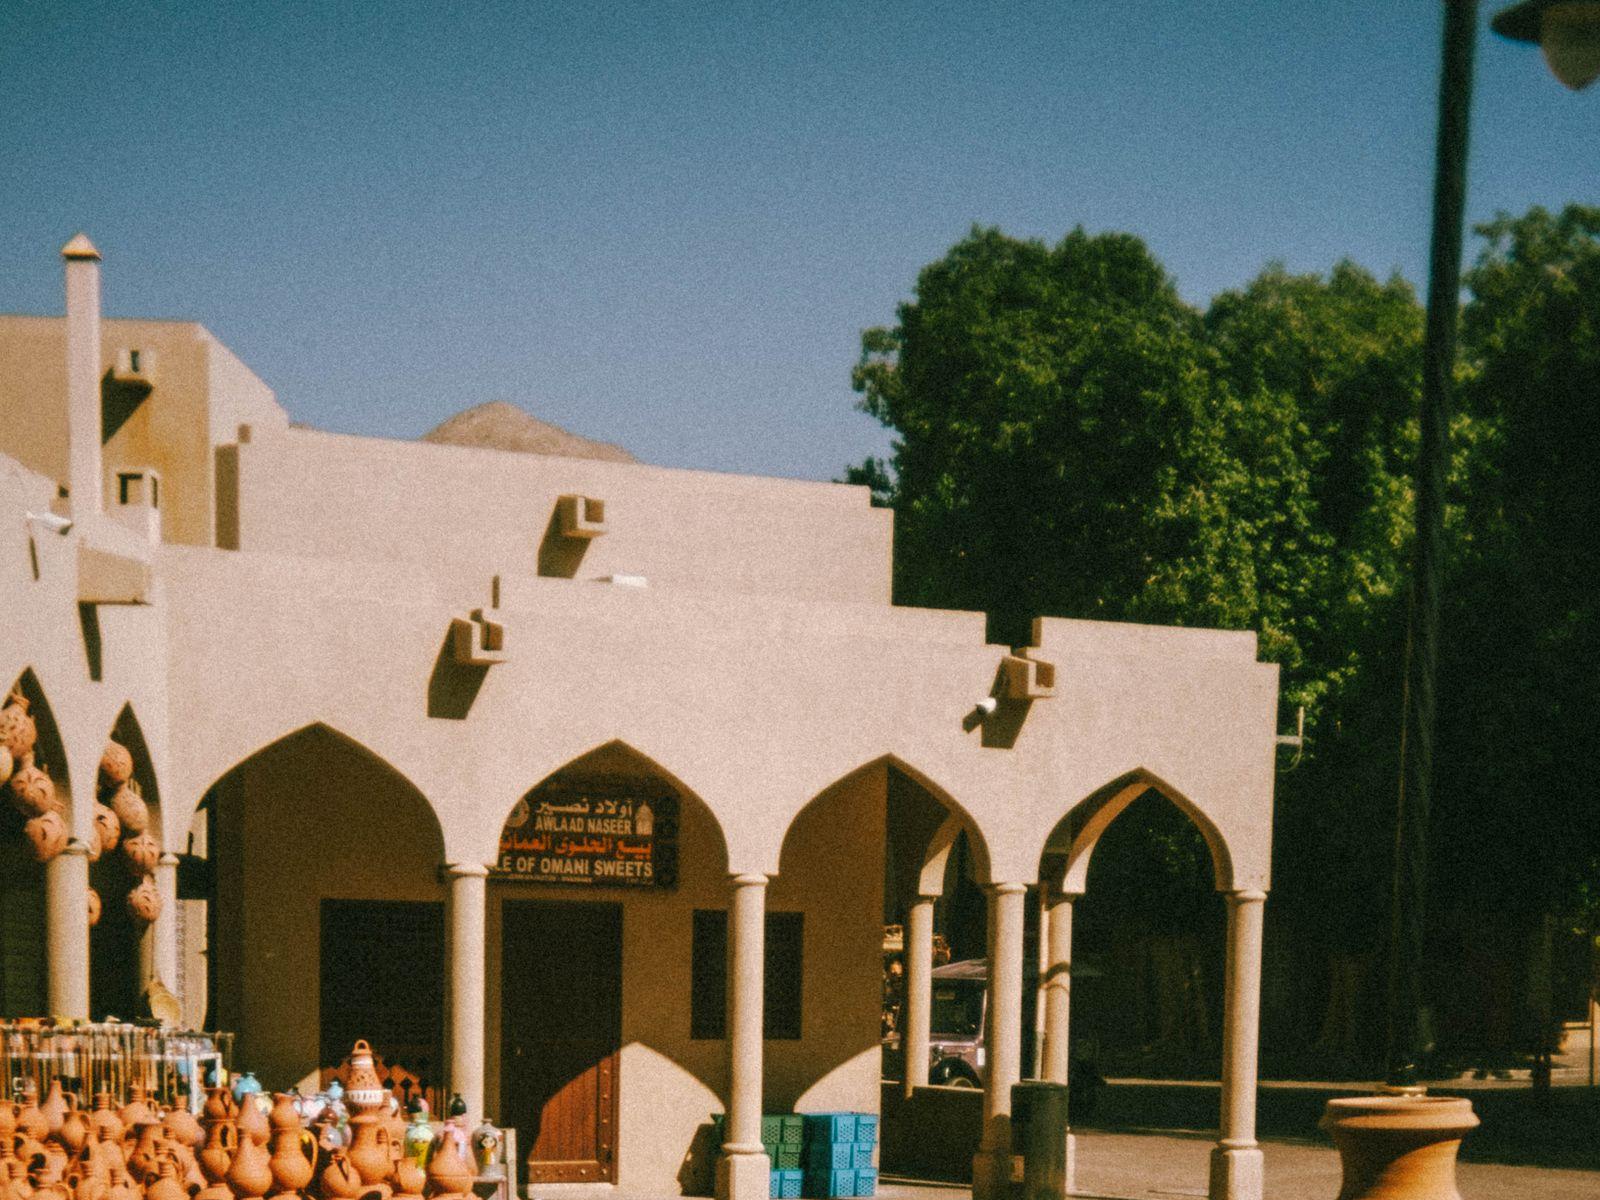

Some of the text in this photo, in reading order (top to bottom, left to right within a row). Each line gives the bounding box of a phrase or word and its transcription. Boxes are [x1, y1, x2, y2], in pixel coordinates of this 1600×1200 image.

[535, 816, 632, 834] AWLAAD NASEER
[516, 857, 535, 873] OF
[540, 858, 589, 875] OMANI
[594, 861, 653, 877] SWEETS
